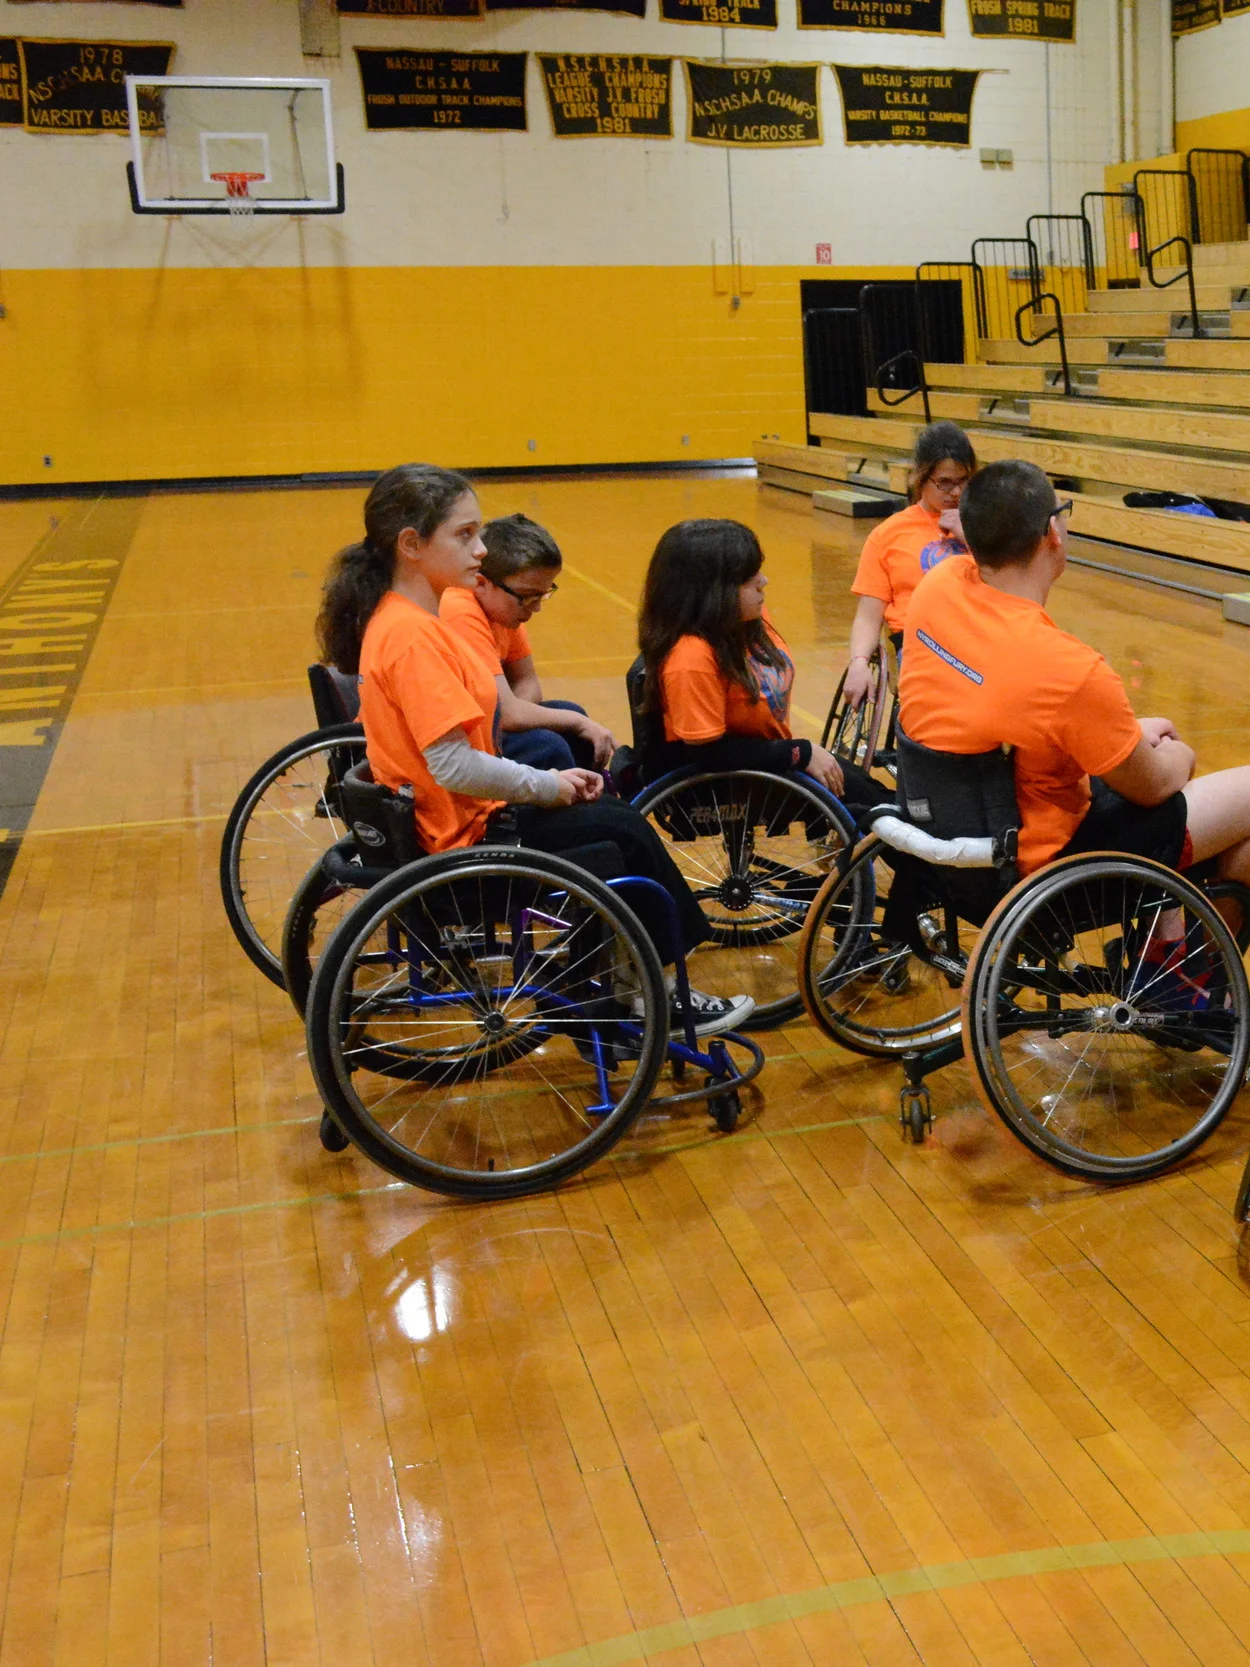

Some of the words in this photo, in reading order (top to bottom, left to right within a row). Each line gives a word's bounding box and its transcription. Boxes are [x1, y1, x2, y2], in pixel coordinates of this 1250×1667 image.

[701, 6, 741, 22] 1984
[832, 1, 912, 15] CHAMPIONS
[79, 47, 123, 64] 1978
[386, 57, 433, 71] NASSAU
[451, 59, 500, 72] SUFFOLK
[548, 72, 593, 88] LEAGUE
[605, 73, 667, 89] CHAMPIONS
[733, 69, 771, 85] 1979
[553, 88, 598, 103] VARSITY
[631, 88, 666, 104] FROSH
[694, 88, 763, 117] NSCHSAA
[767, 90, 816, 120] CHAMPS
[31, 107, 93, 126] VARSITY
[433, 110, 462, 123] 1972
[562, 103, 599, 118] CROSS
[611, 103, 659, 119] COUNTRY
[596, 118, 632, 133] 1981
[733, 124, 807, 140] LACROSSE
